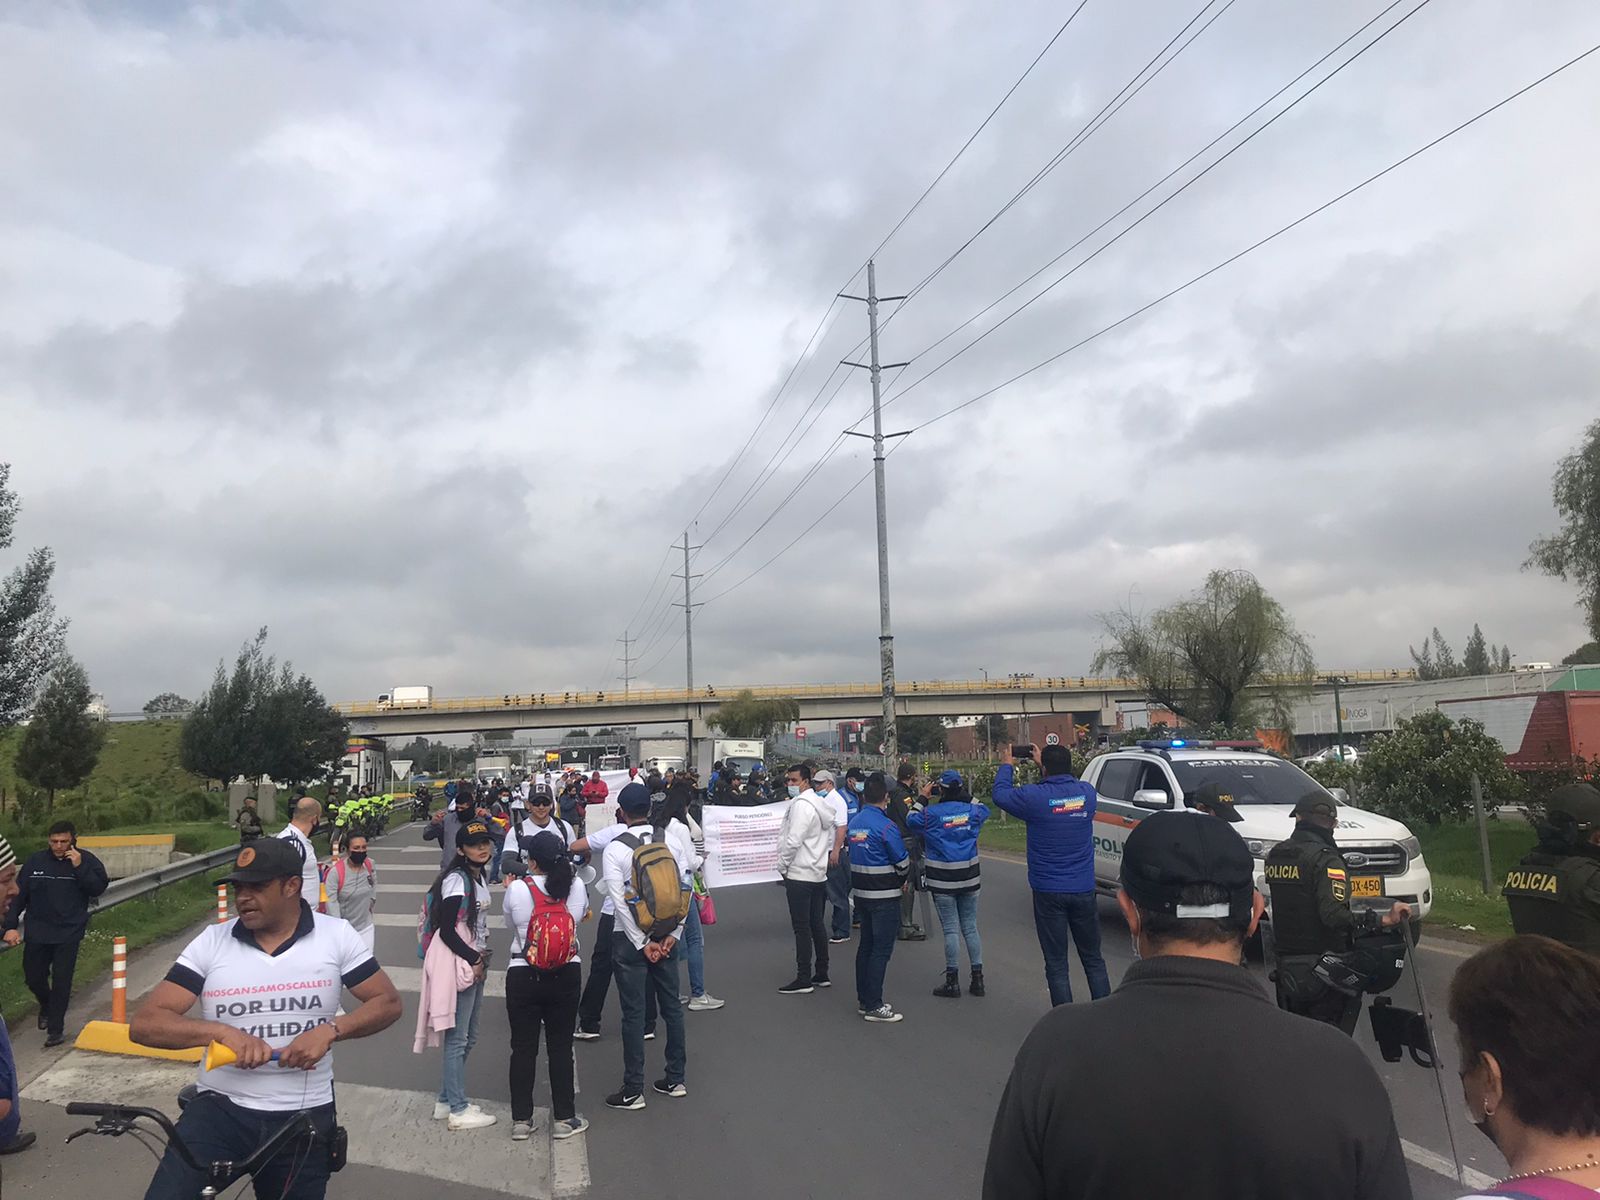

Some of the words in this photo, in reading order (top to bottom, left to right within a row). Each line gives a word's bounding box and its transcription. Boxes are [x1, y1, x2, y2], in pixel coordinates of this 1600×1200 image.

[1047, 735, 1058, 744] 30
[1093, 836, 1124, 854] POL
[1504, 871, 1558, 893] POLICIA
[215, 1000, 263, 1018] POR
[270, 995, 323, 1012] UNA
